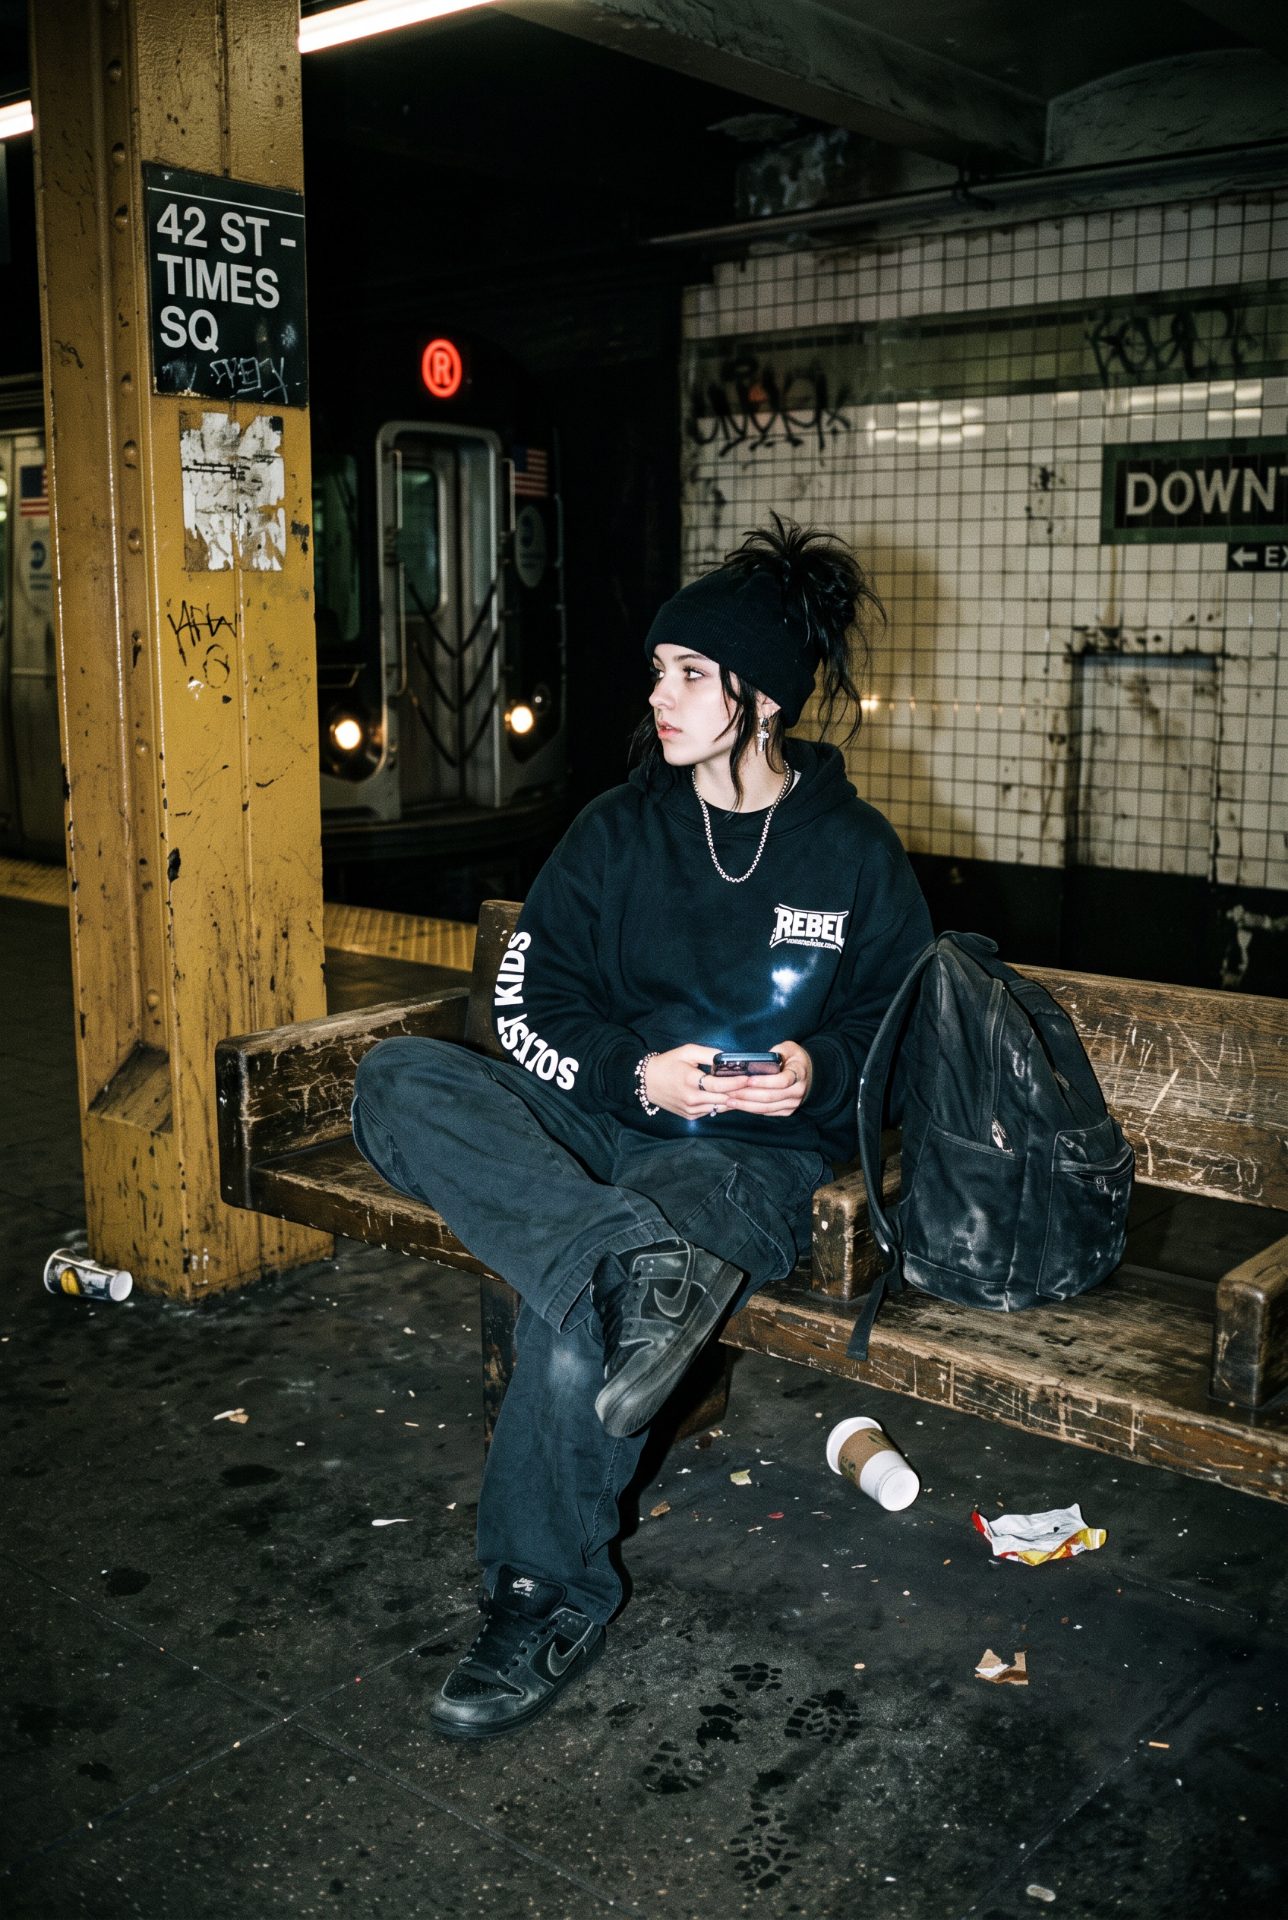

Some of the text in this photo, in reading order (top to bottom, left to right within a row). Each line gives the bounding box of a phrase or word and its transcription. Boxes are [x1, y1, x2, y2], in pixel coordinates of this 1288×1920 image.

[157, 203, 208, 248] 42
[220, 212, 270, 257] ST
[157, 253, 280, 309] TIMES
[160, 305, 219, 353] SQ
[1125, 466, 1288, 516] DOWN
[773, 907, 846, 949] REBEL
[494, 931, 532, 1006] KIDS
